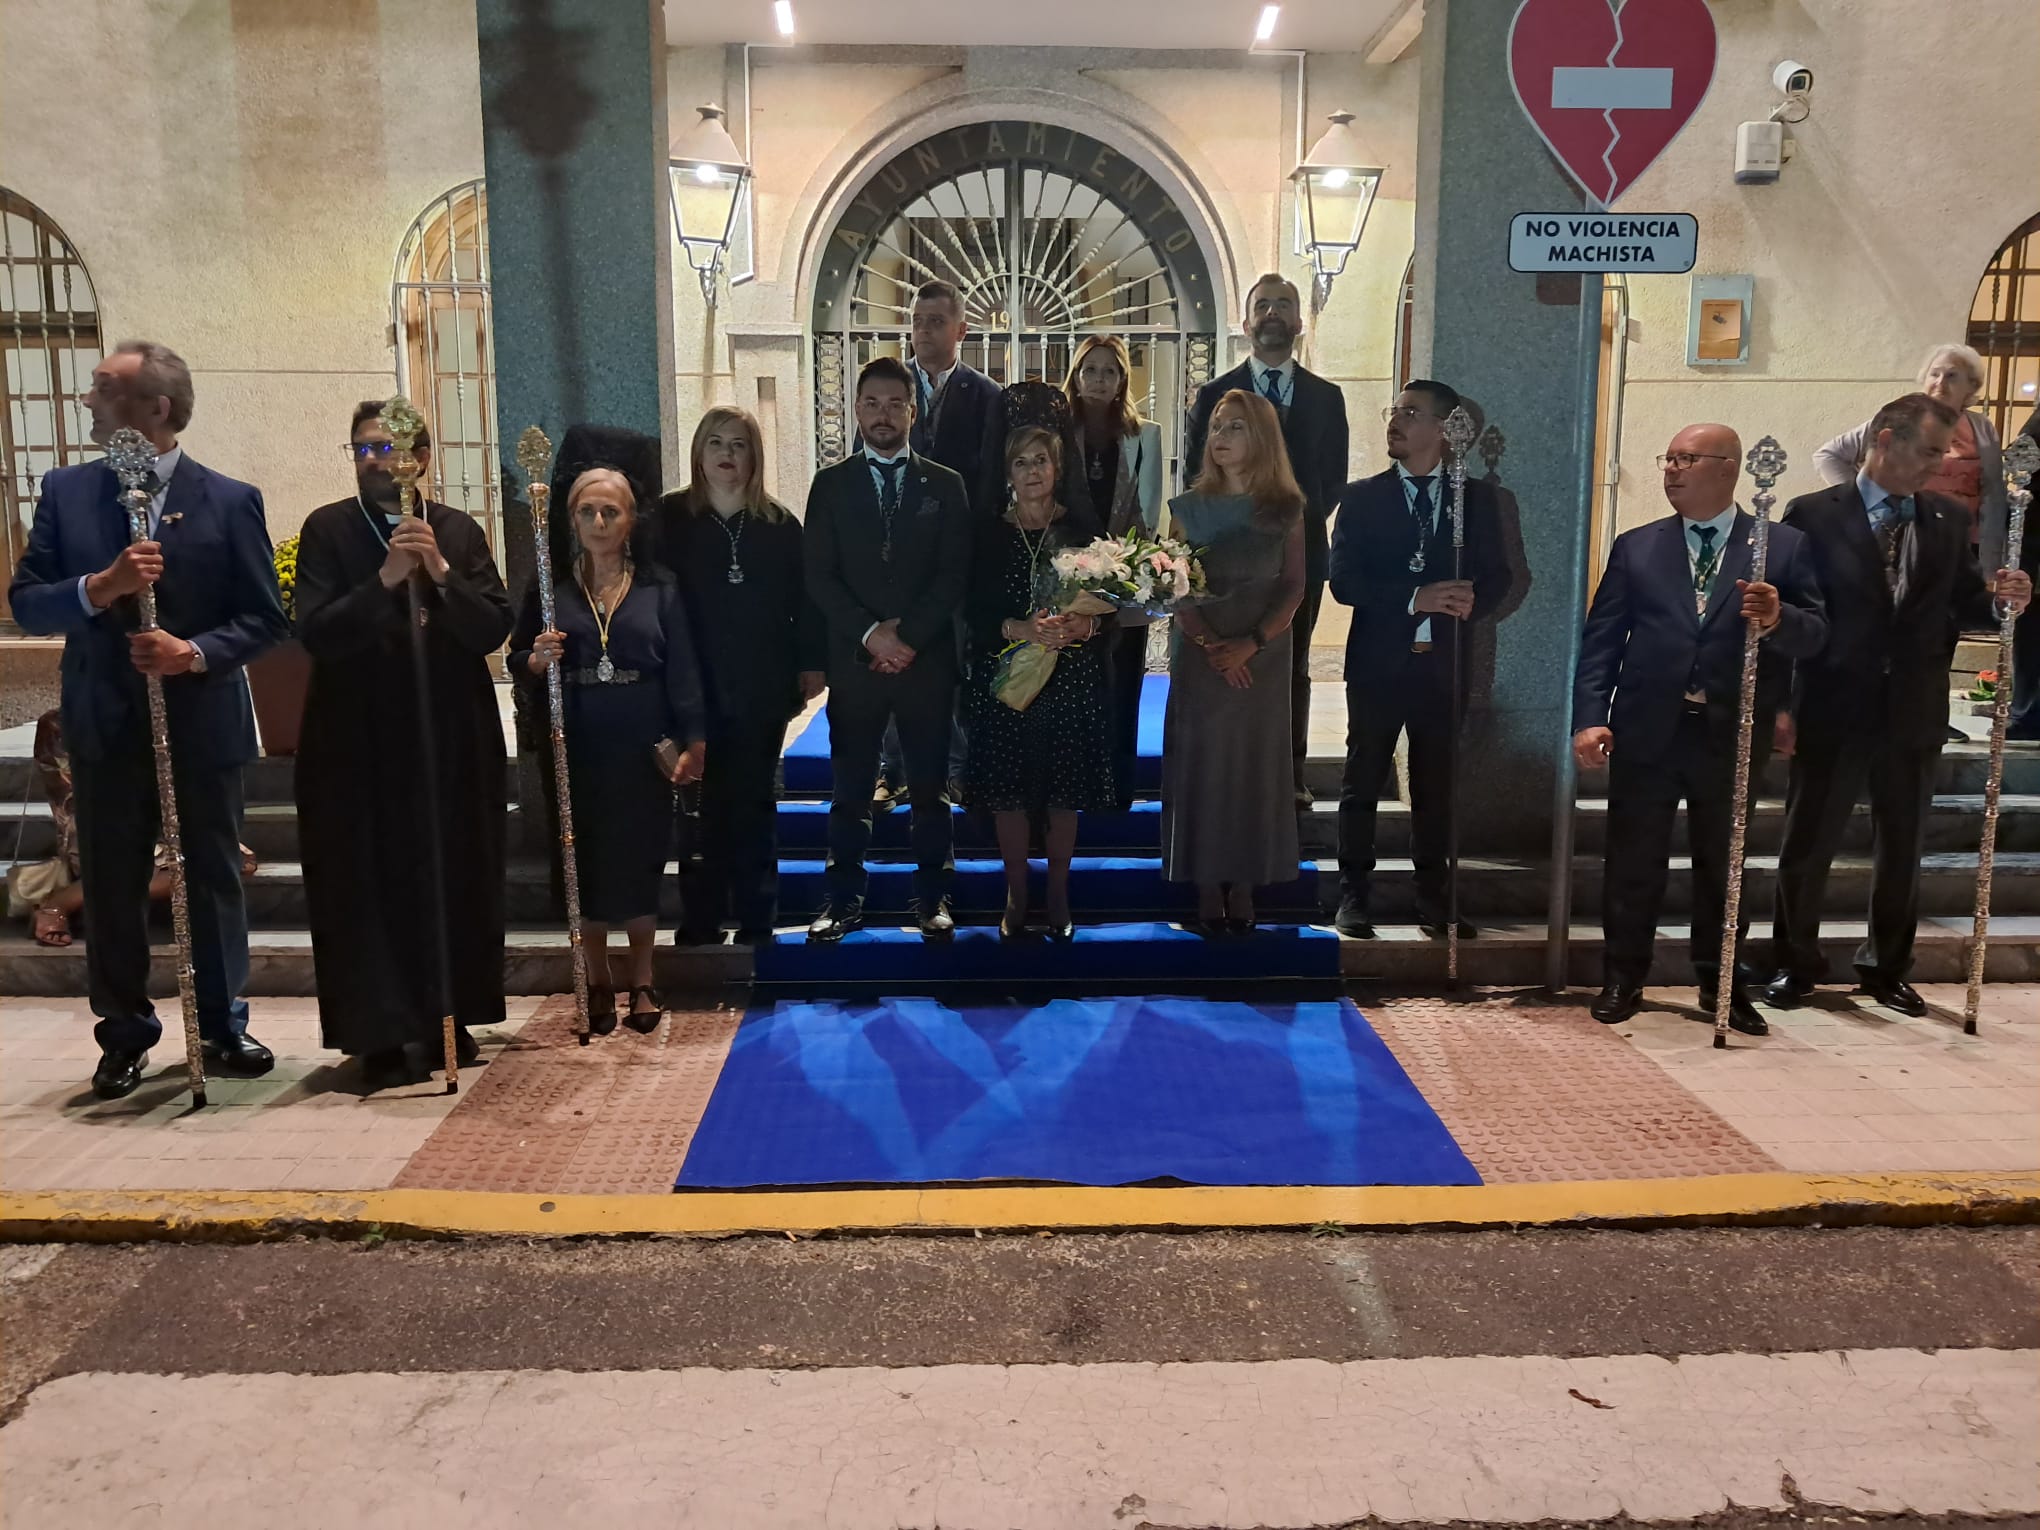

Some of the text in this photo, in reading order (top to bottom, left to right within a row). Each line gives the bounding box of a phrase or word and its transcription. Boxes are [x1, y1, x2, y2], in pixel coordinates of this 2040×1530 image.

[835, 121, 1193, 253] AYUNTAMIENTO
[1525, 220, 1680, 238] NO VIOLENCIA
[1547, 245, 1655, 263] MACHISTA
